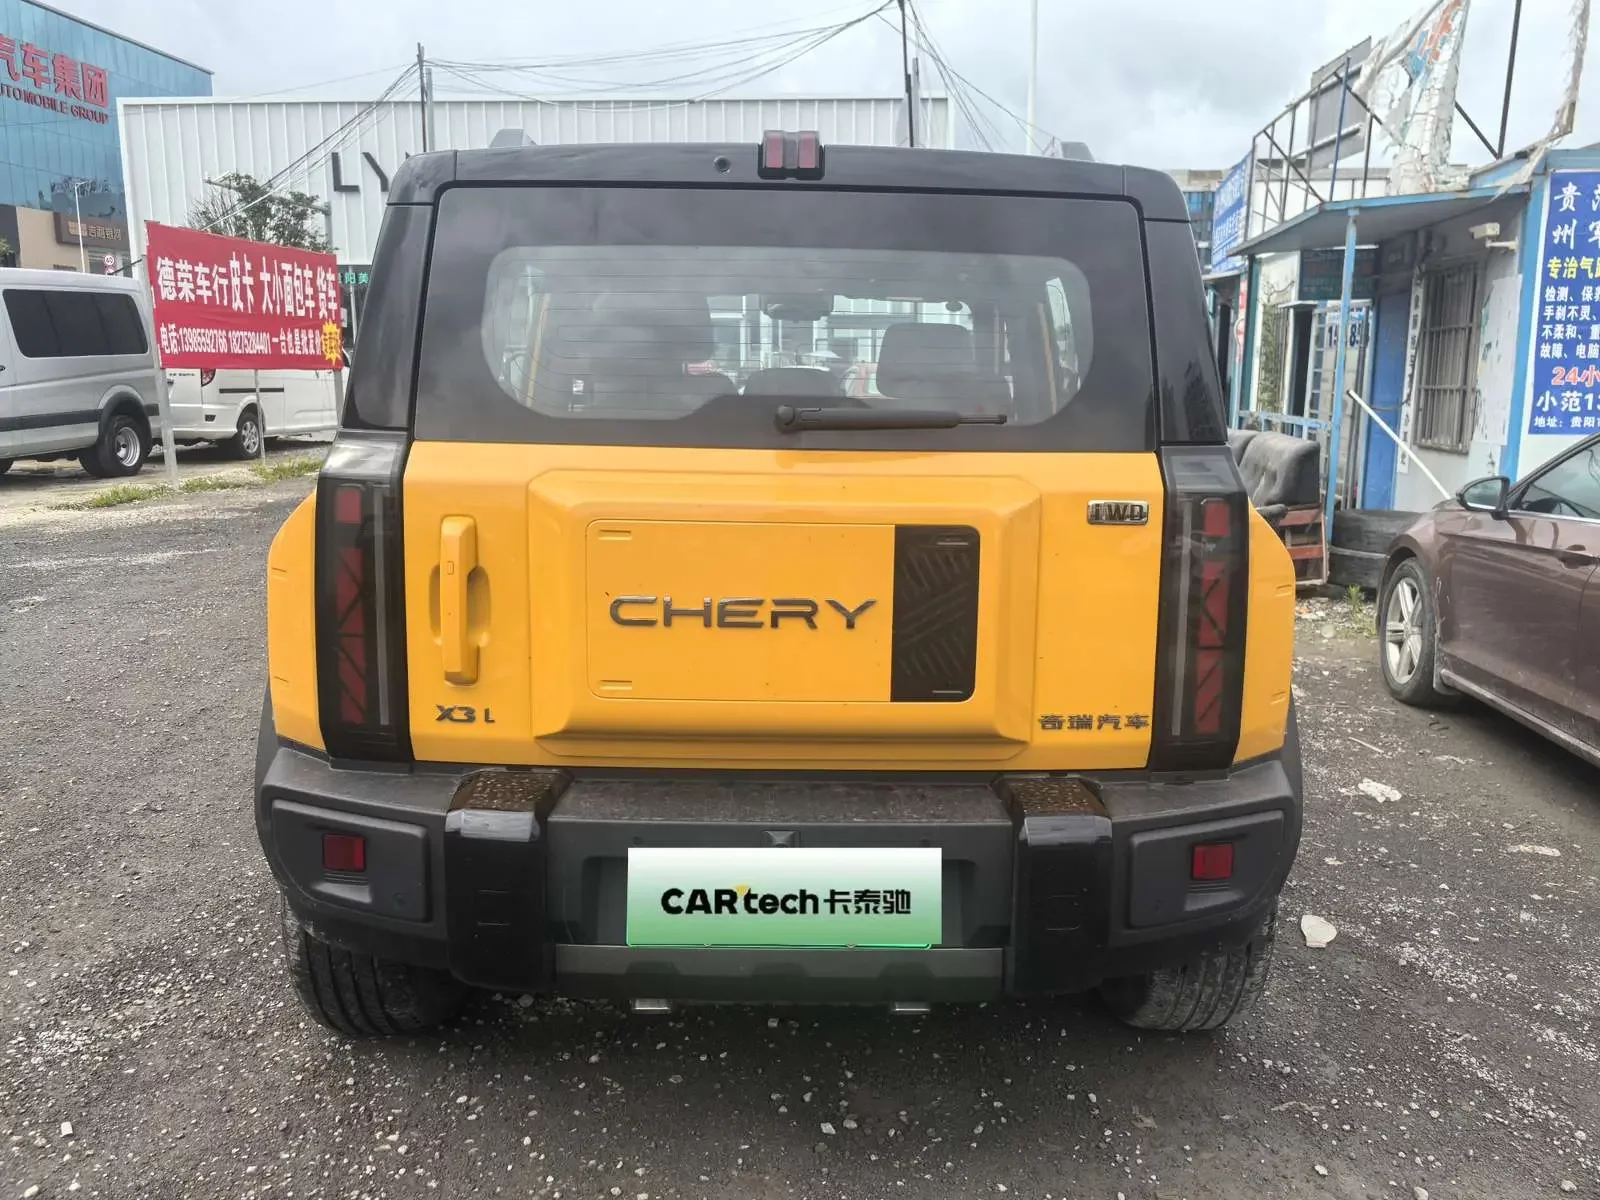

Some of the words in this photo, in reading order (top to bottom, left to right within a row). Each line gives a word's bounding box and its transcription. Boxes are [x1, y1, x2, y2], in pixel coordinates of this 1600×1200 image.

[71, 104, 110, 124] GROUP
[157, 251, 255, 313] 德荣车行皮卡
[260, 256, 315, 318] 大小面包车
[316, 265, 338, 320] 货车
[609, 594, 877, 630] CHERY
[1038, 712, 1150, 731] 奇瑞汽车
